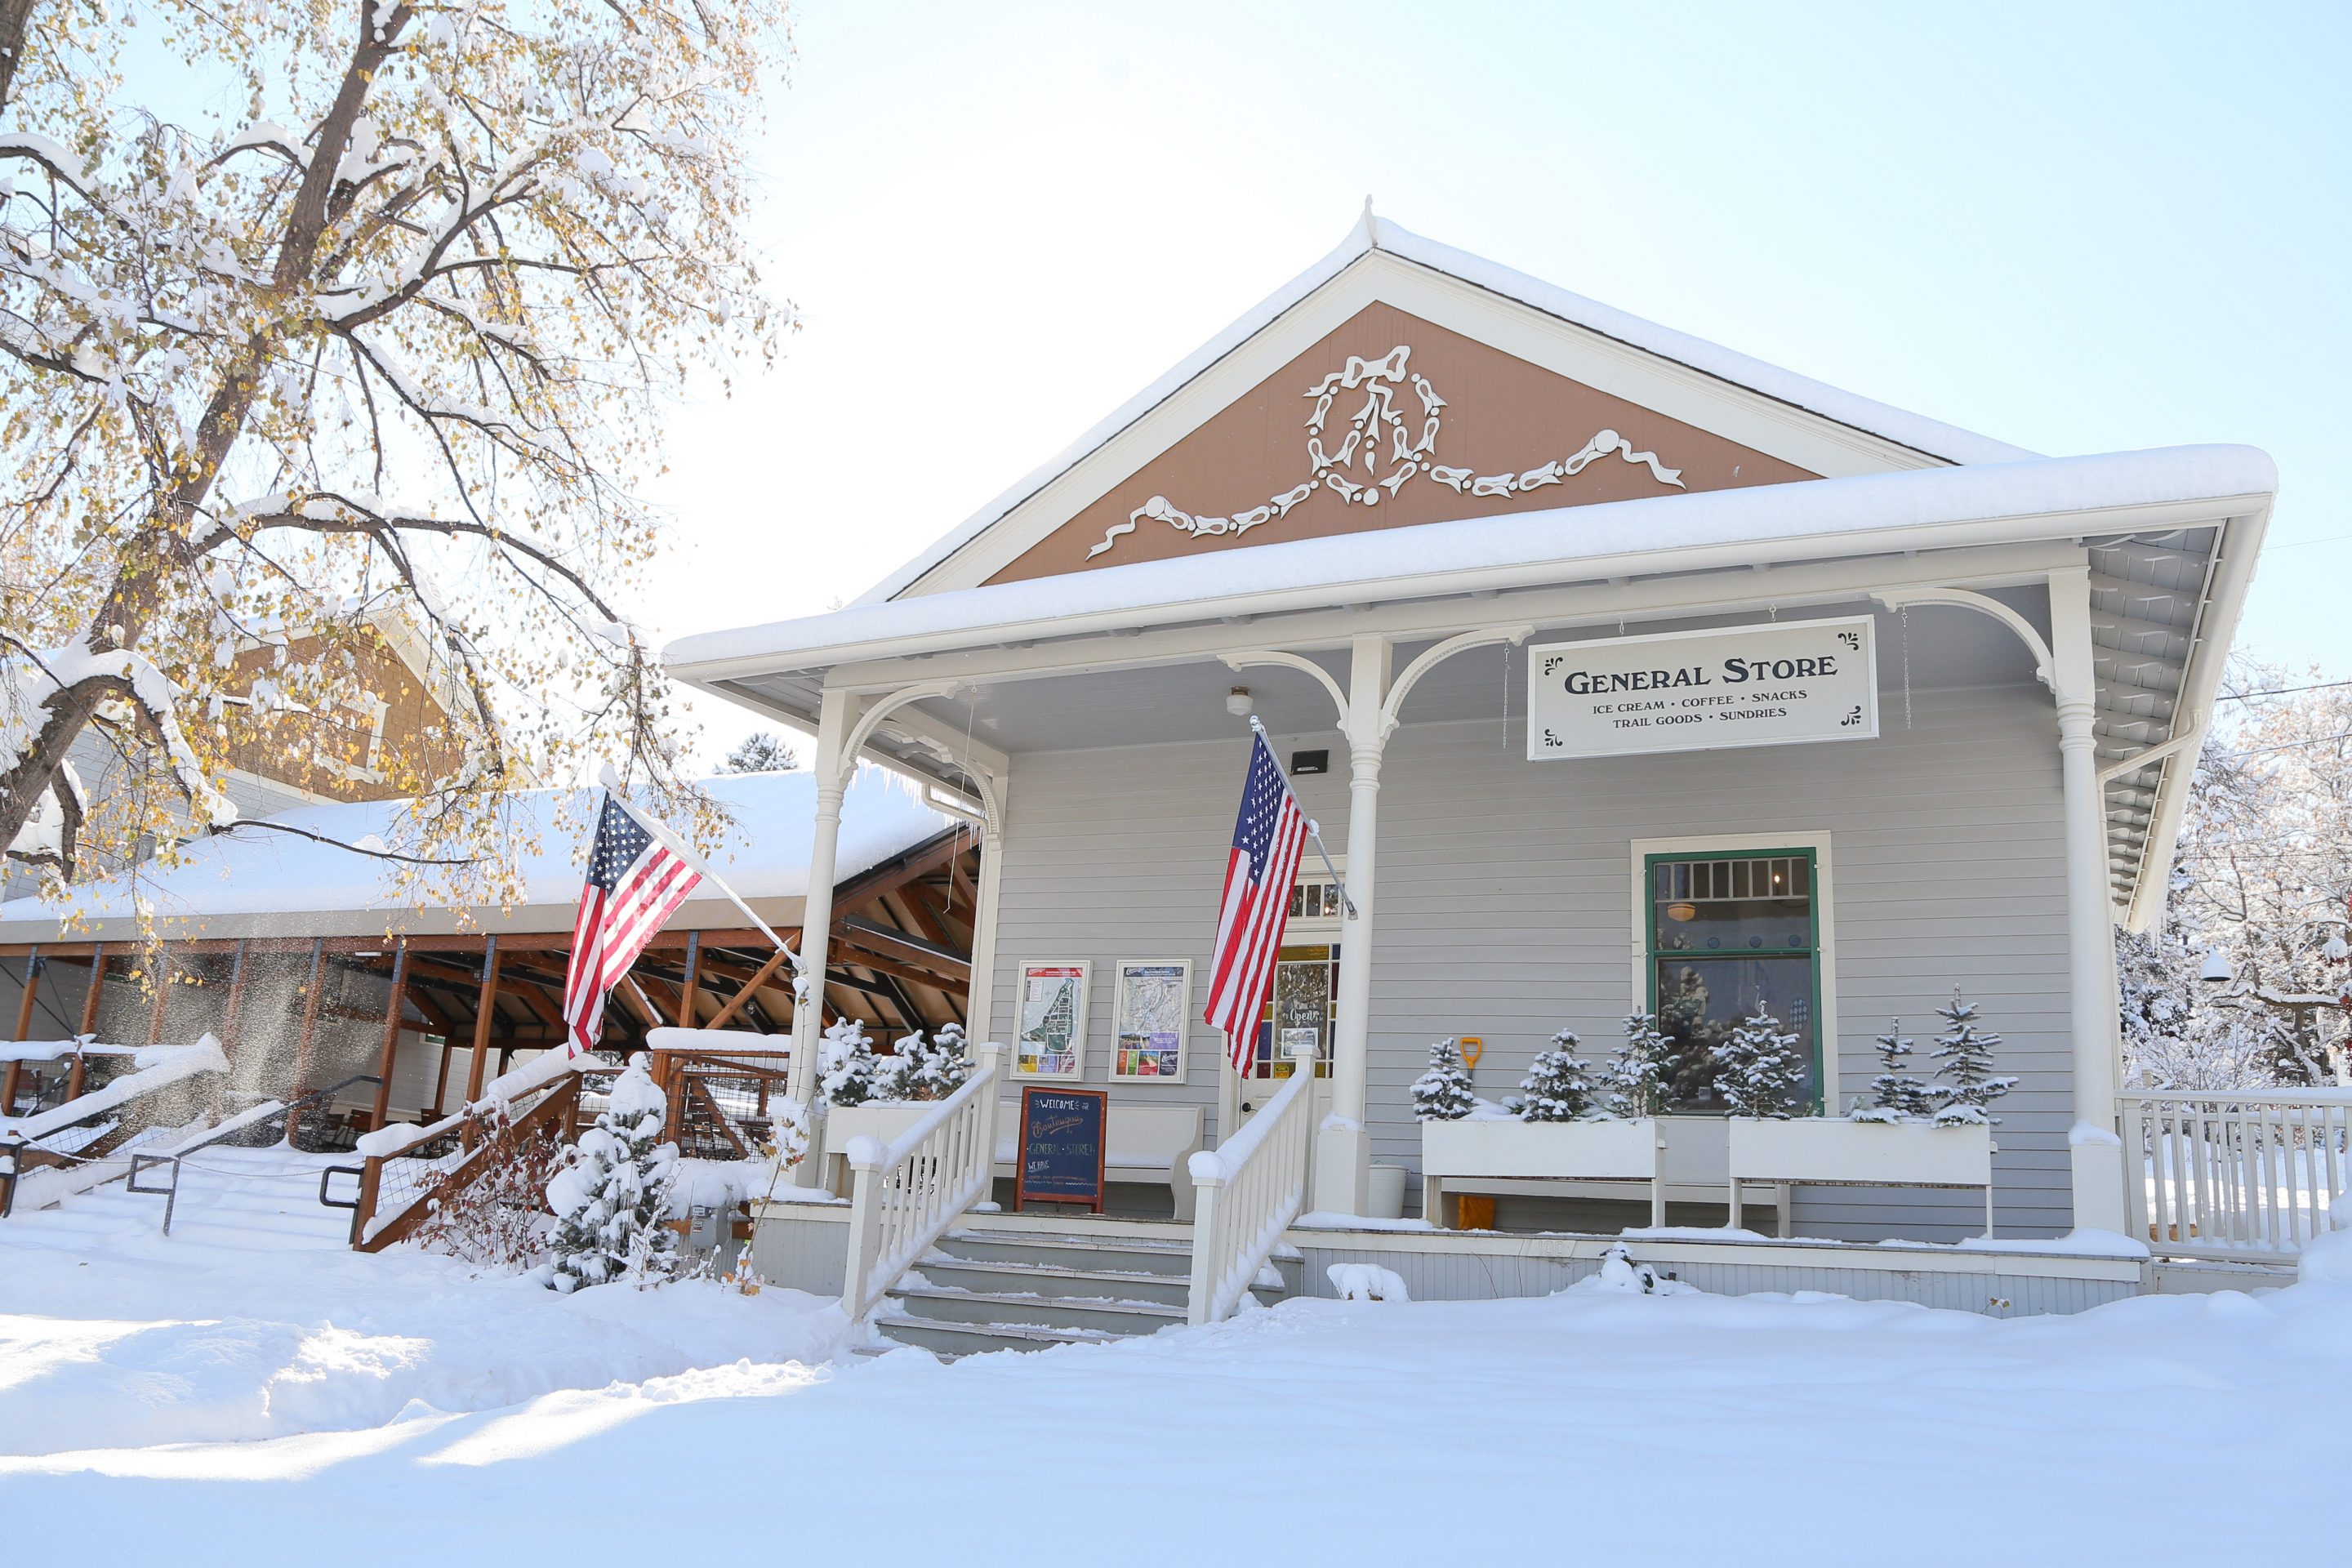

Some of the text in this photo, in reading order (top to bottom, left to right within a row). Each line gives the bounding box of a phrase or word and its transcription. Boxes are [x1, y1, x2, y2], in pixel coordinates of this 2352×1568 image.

[1564, 656, 1839, 695] GENERAL STORE
[1592, 689, 1808, 715] ICE CREAM COFFEE SNACKS
[1613, 707, 1788, 728] TRAIL GOODS SUNDRIES
[1040, 1098, 1075, 1111] WELCOME
[1029, 1143, 1061, 1156] GENERAL
[1027, 1160, 1050, 1170] WE HAVE
